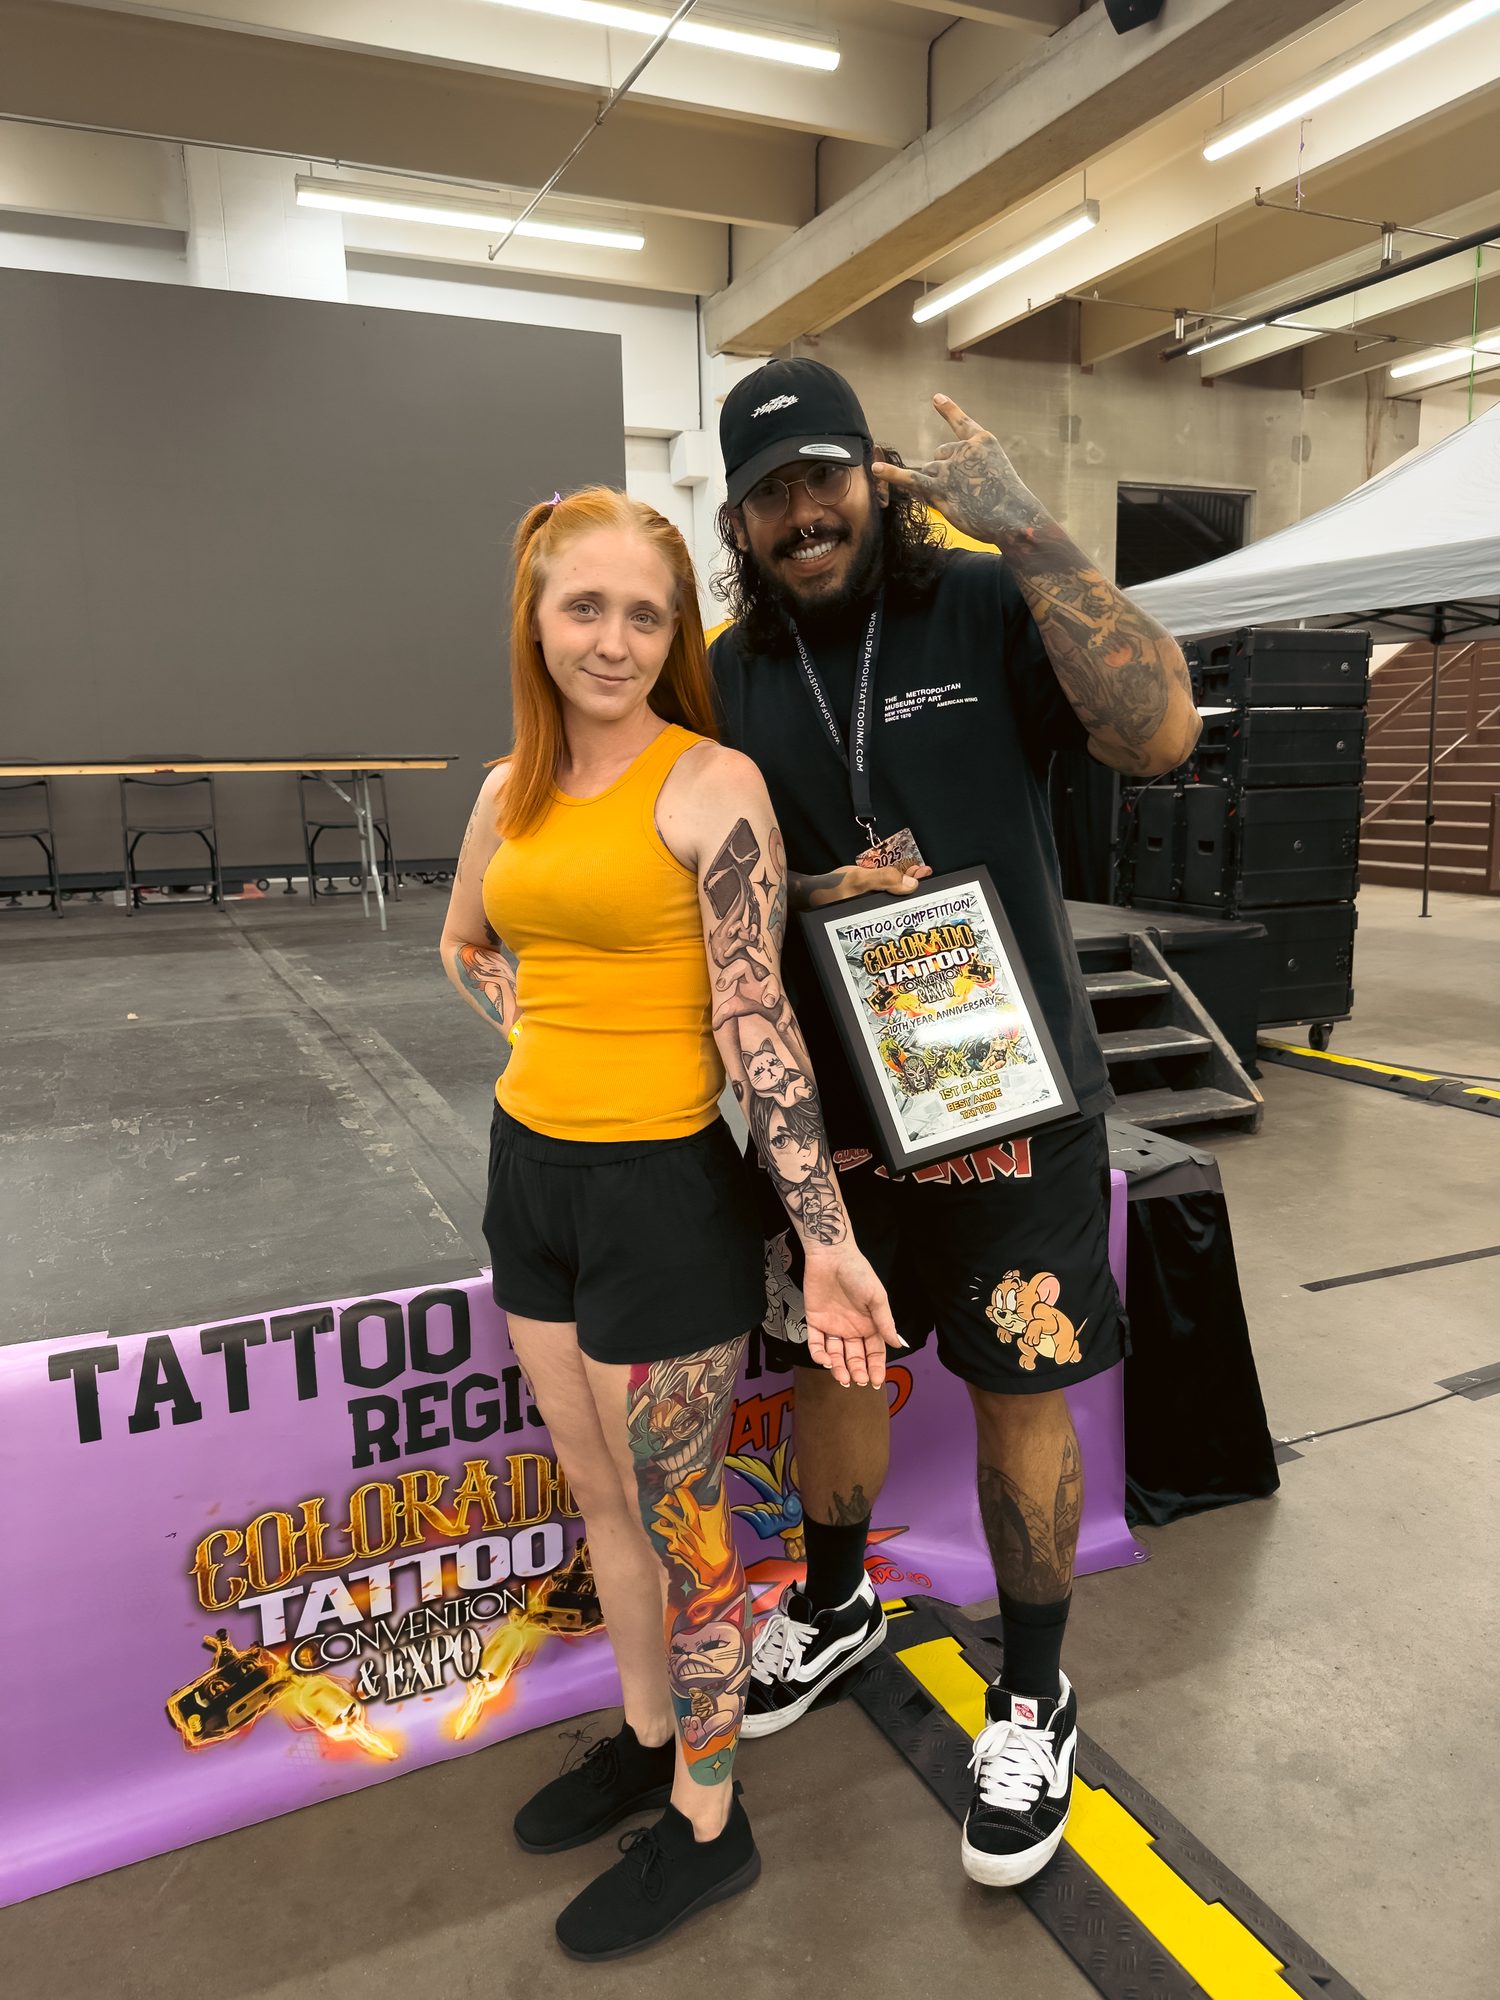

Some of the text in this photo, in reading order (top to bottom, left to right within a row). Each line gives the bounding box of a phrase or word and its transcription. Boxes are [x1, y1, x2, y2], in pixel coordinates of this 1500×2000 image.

[855, 611, 877, 772] WORLDFAMOUSTATTOOINK.COM
[884, 682, 961, 704] THE METROPOLITAN
[884, 700, 915, 711] MUSEUM
[927, 694, 942, 702] ART
[936, 698, 964, 708] AMERICAN
[884, 715, 899, 723] SINCE
[896, 707, 911, 715] YORK
[911, 704, 923, 712] CITY
[873, 846, 902, 868] 2025
[845, 898, 971, 943] TATTOO COMPETITION
[864, 923, 975, 975] COLORADO
[879, 948, 970, 985] TATTOO
[888, 995, 997, 1035] 10TH YEAR ANNIVERSARY
[939, 1074, 1001, 1100] 1ST PLACE
[946, 1087, 1003, 1112] BEST ANIME
[960, 1101, 997, 1119] TATTOO
[48, 1287, 471, 1444] TATTOO
[238, 1523, 563, 1649] TATTOO
